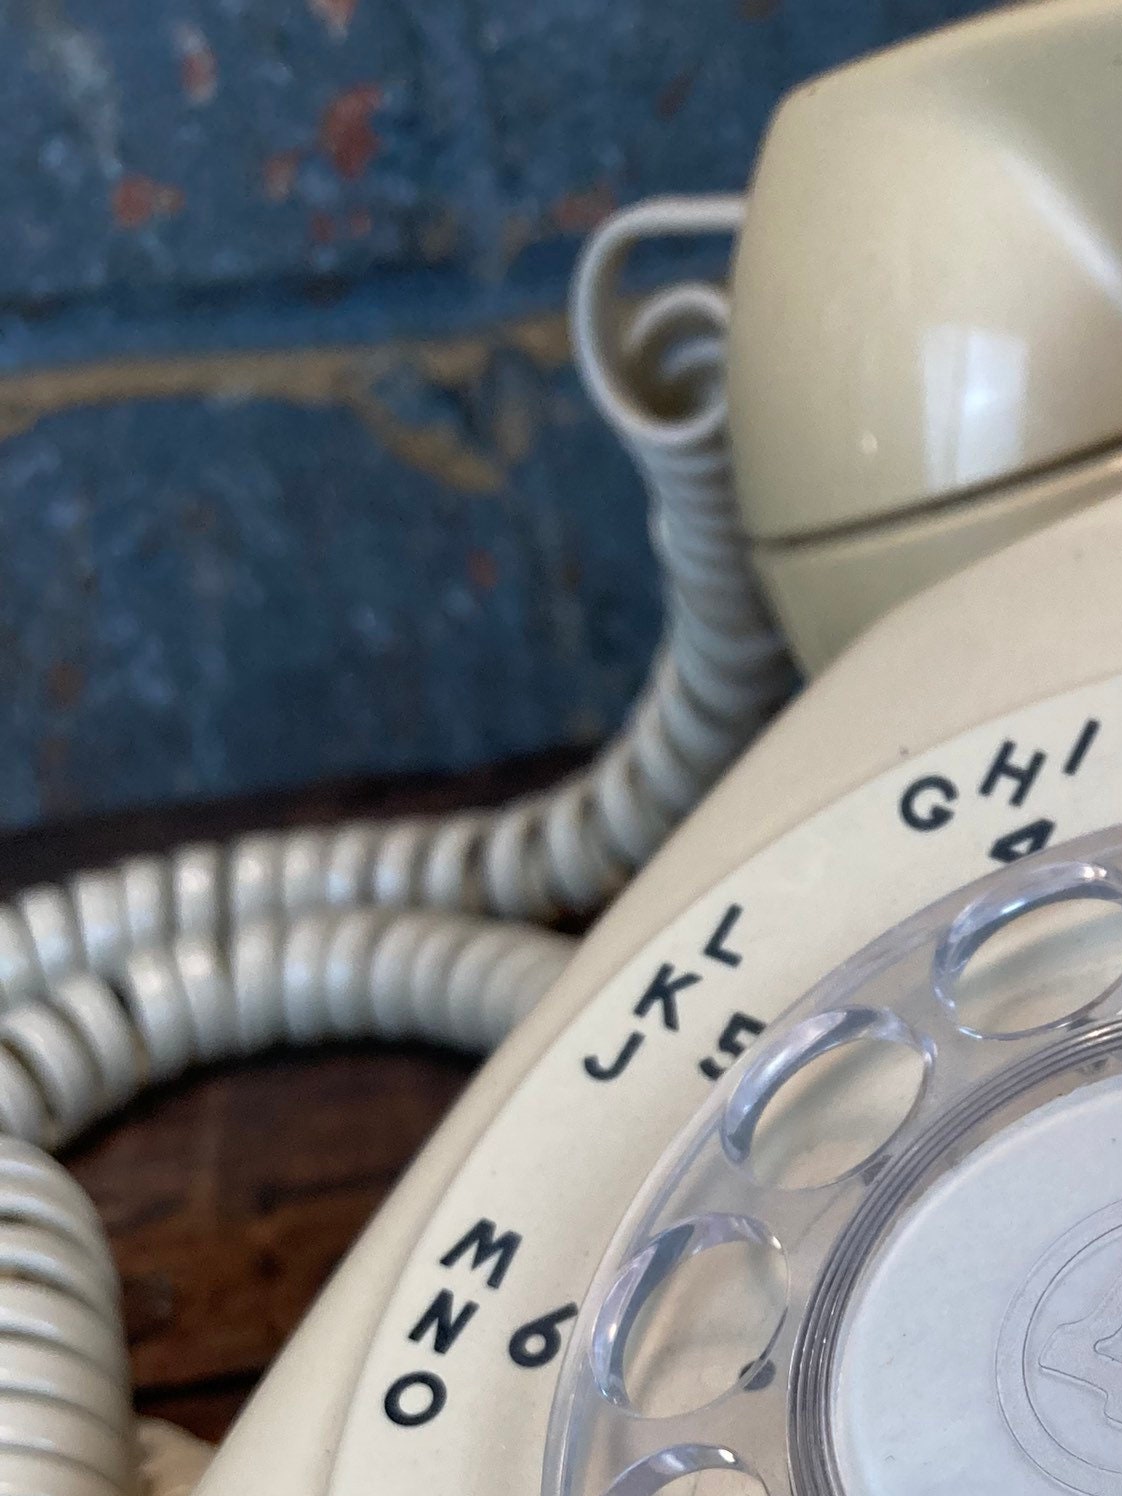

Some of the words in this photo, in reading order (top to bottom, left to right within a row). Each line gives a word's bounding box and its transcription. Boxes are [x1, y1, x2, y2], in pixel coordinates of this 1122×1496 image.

[899, 718, 1100, 833] GHI
[583, 903, 743, 1082] JKL
[382, 1218, 523, 1429] MNO
[508, 1302, 579, 1370] 6
